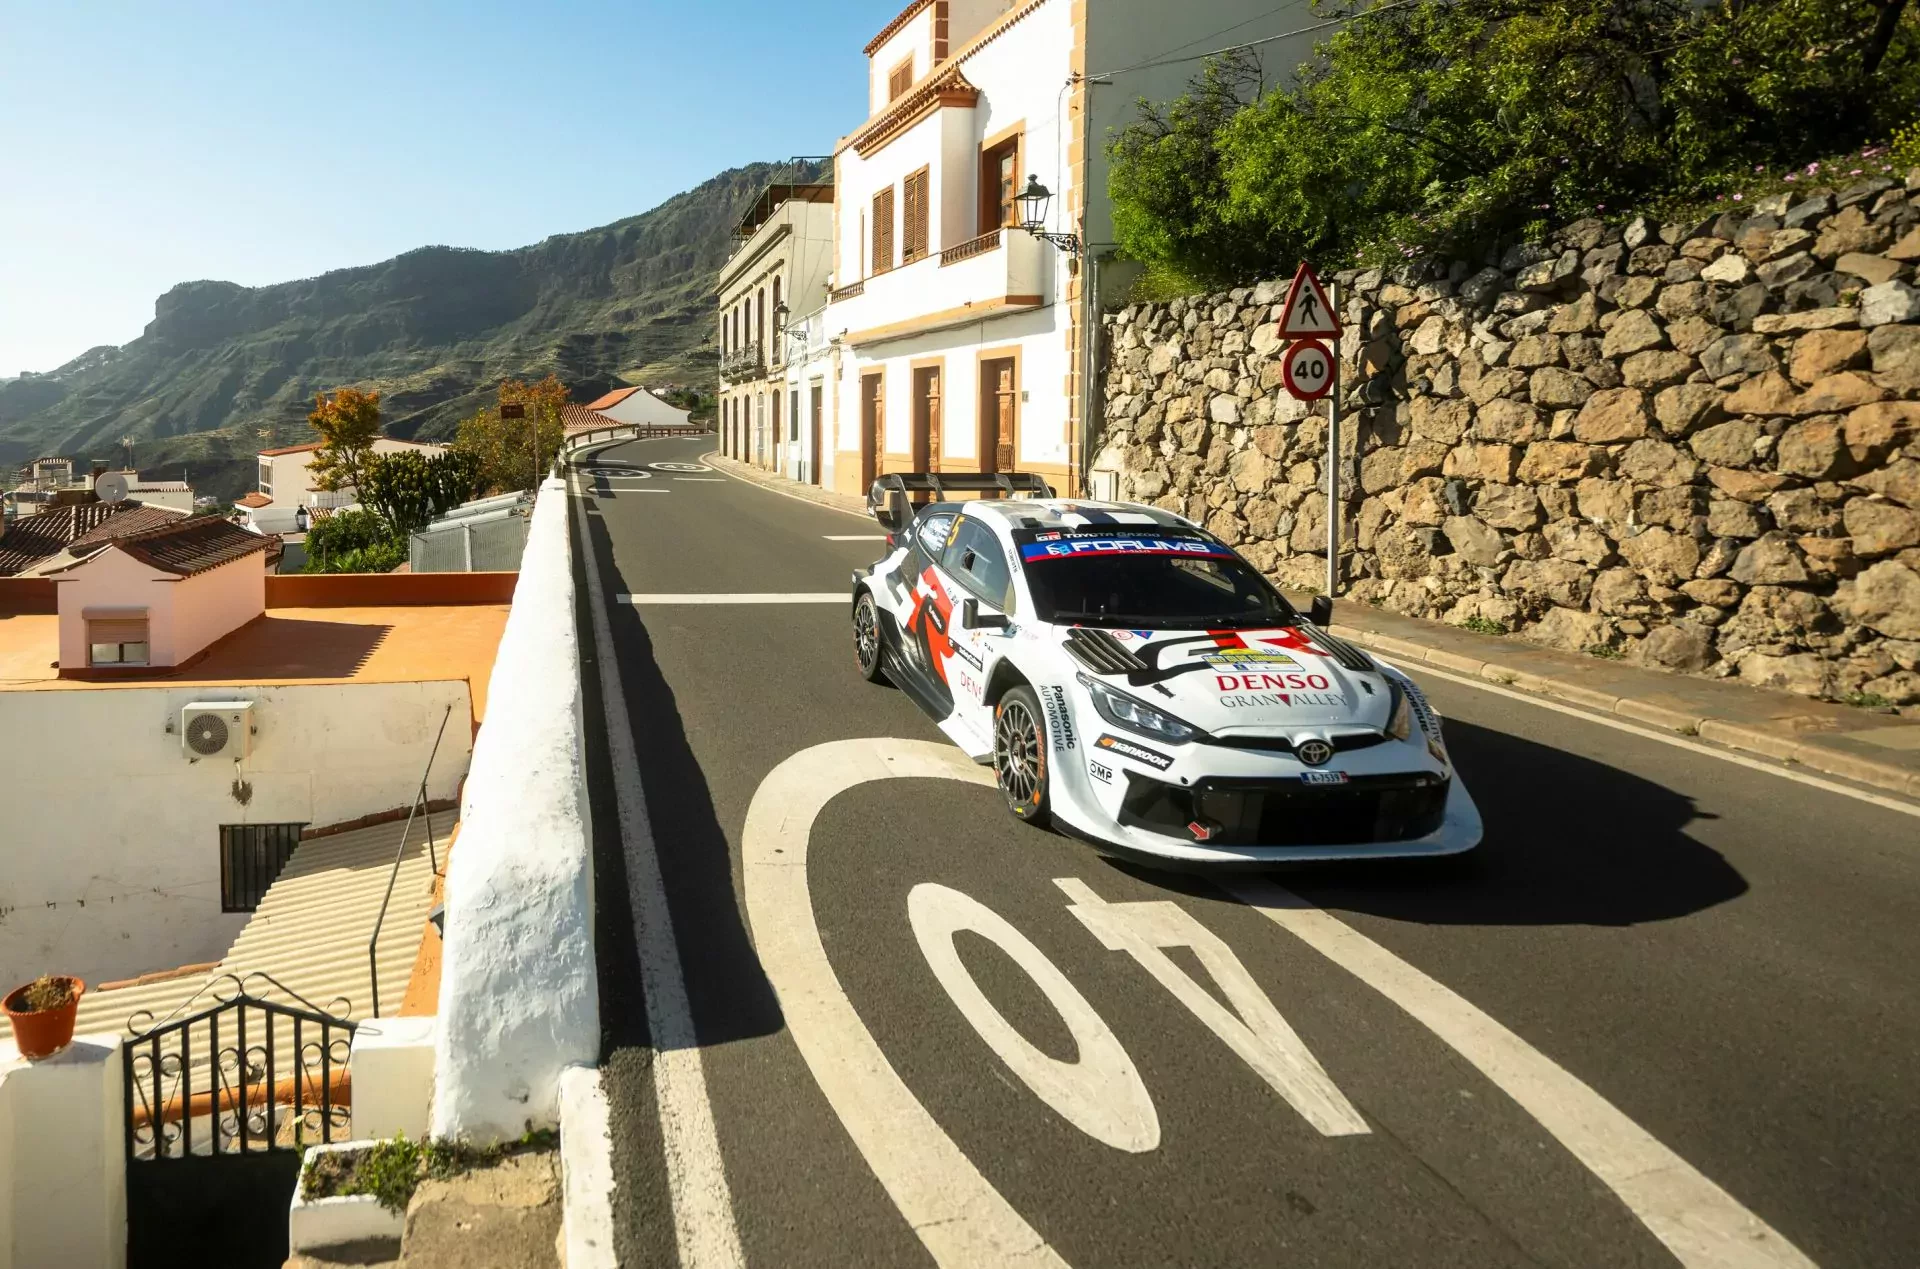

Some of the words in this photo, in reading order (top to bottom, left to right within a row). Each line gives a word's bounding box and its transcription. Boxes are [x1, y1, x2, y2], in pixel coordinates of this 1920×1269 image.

[1294, 360, 1325, 379] 40
[1070, 540, 1211, 553] FORUM8
[1214, 674, 1330, 692] DENSO
[1040, 685, 1065, 752] AUTOMOTIVE
[1051, 685, 1077, 750] Panasonic
[1090, 763, 1113, 781] OMP
